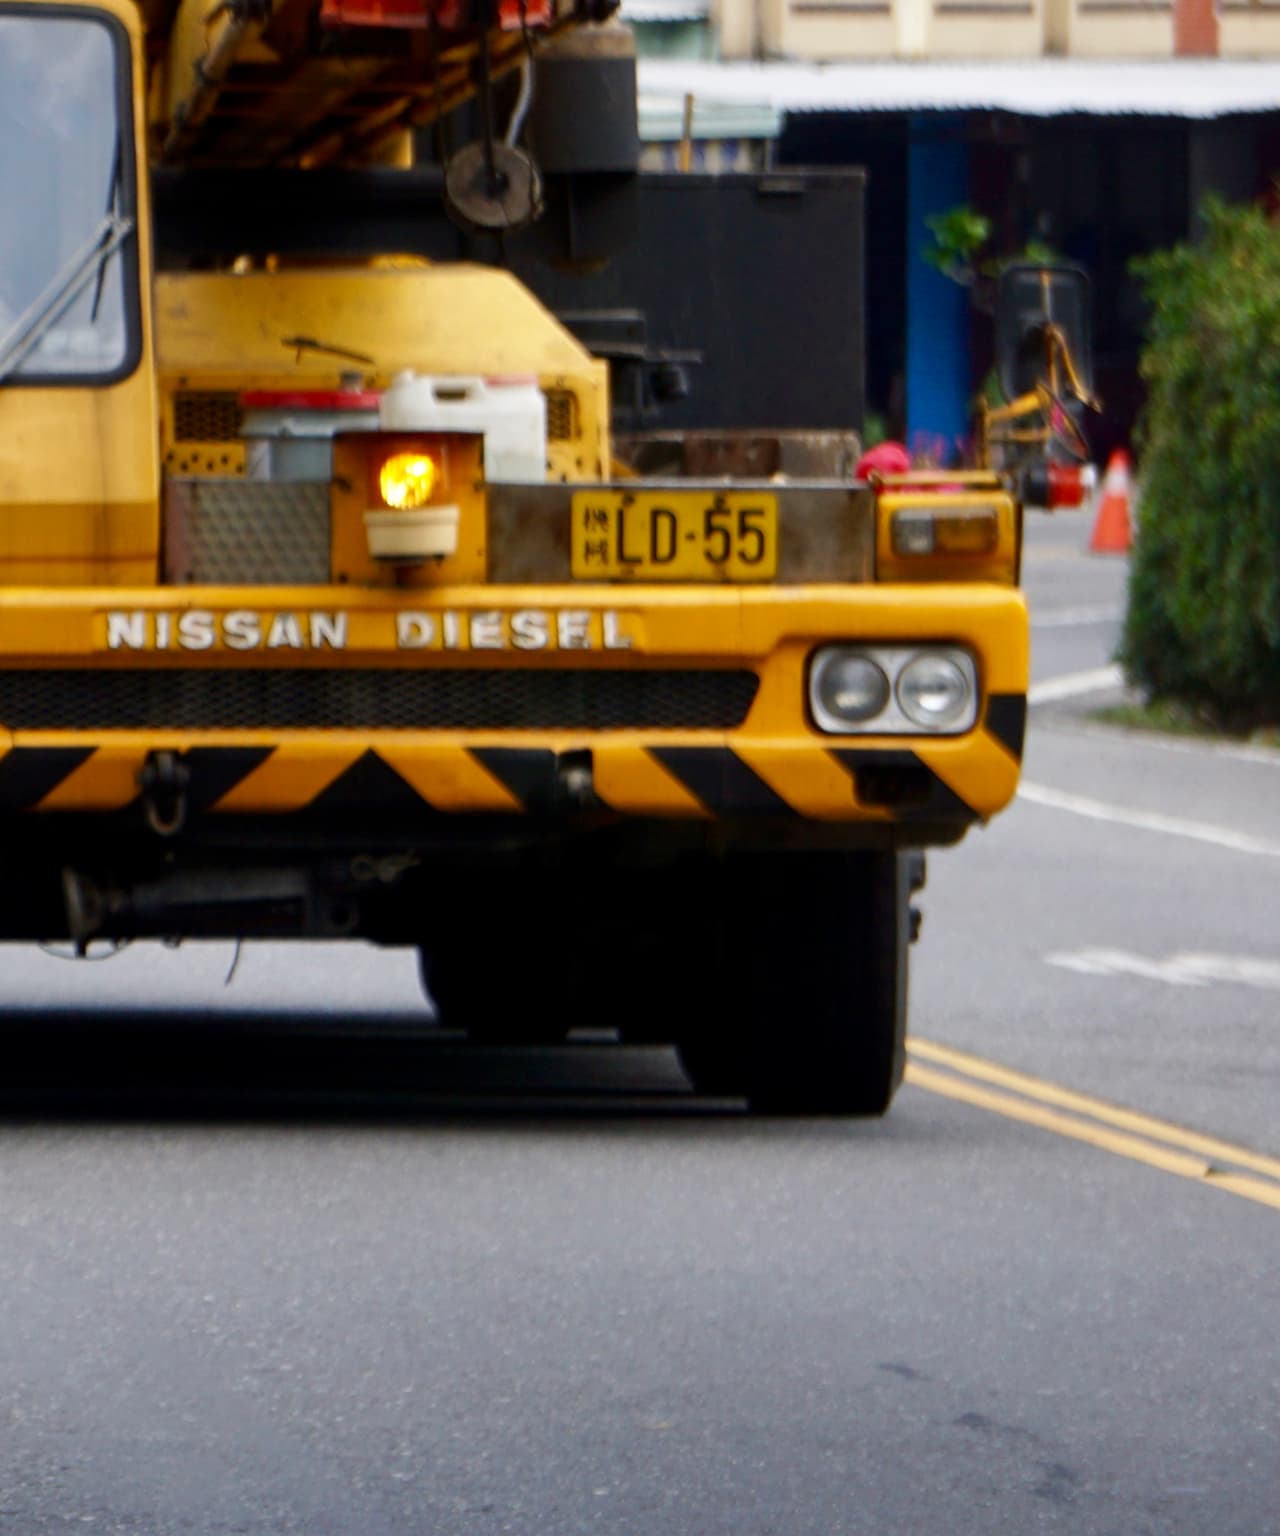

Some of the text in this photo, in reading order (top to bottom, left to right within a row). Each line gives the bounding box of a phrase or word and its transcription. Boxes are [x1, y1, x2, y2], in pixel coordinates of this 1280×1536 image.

[616, 508, 766, 565] LD-55
[106, 610, 633, 650] NISSAN DIESEL
